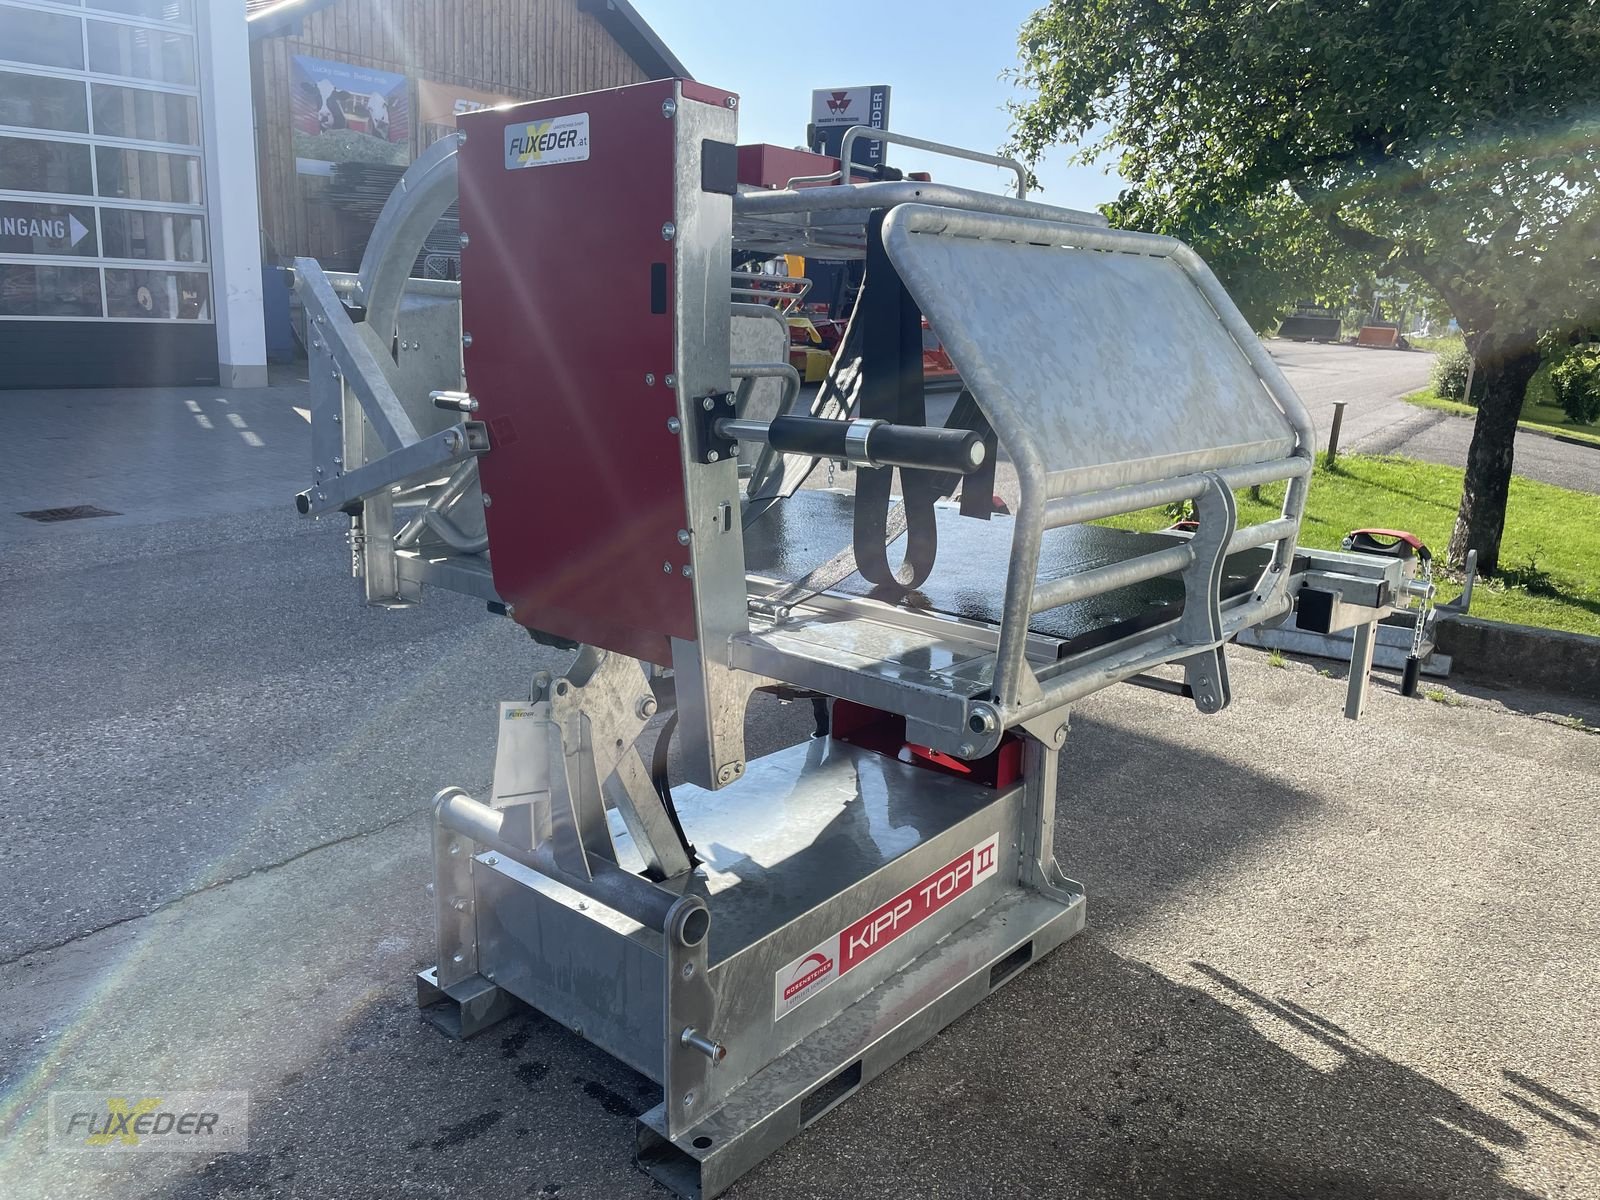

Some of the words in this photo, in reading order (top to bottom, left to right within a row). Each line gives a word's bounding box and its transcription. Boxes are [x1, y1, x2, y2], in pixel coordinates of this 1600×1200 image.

[869, 92, 883, 158] FLIEDER
[849, 899, 913, 960] KIPP
[919, 860, 972, 908] TOP
[786, 962, 832, 996] ROSENSTEINER
